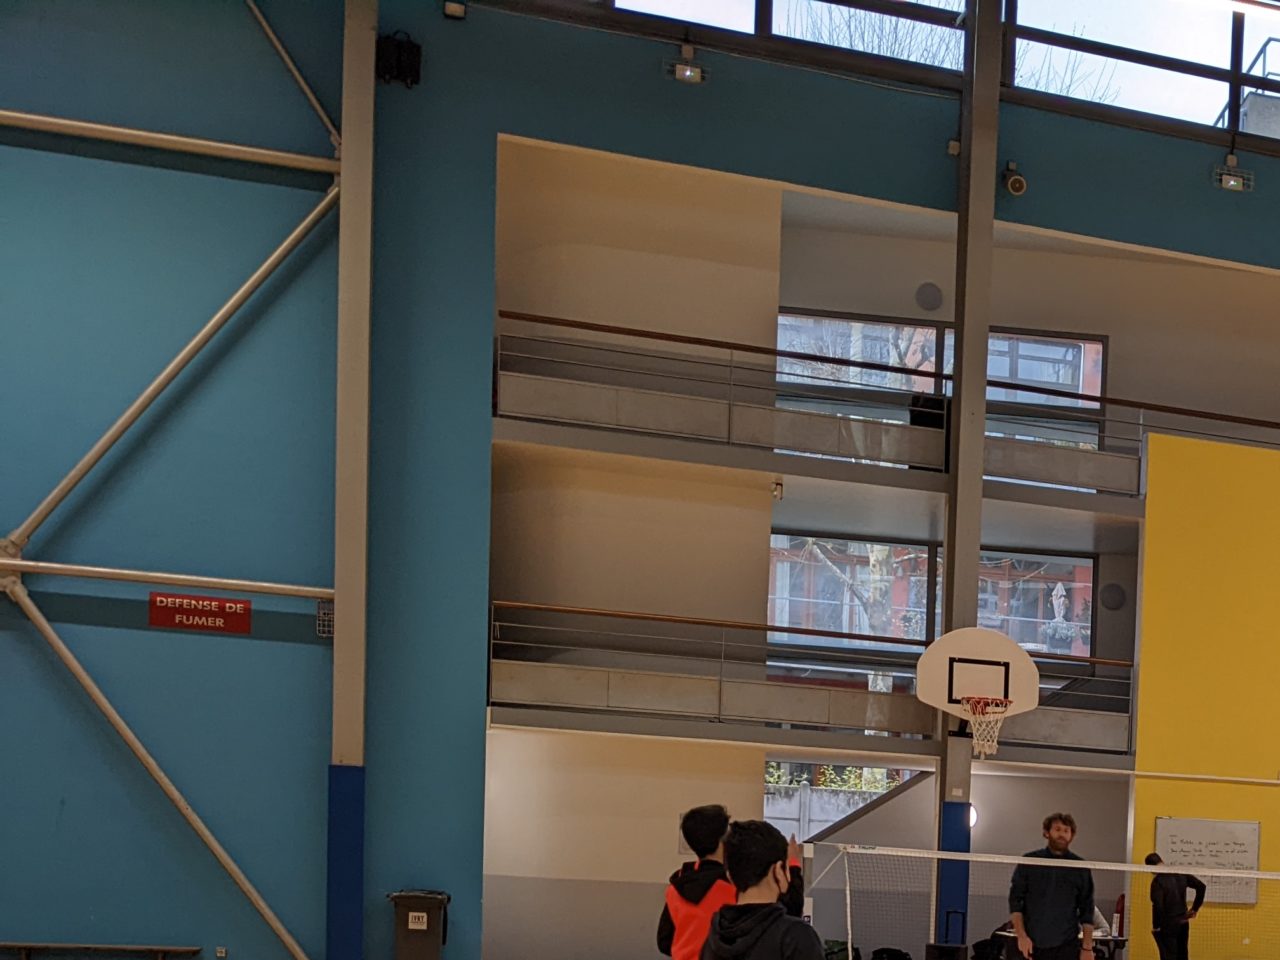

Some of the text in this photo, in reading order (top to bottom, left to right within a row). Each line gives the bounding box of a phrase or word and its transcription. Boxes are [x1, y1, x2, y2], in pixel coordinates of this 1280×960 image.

[156, 597, 244, 613] DEFENSE DE
[175, 614, 225, 627] FUMER
